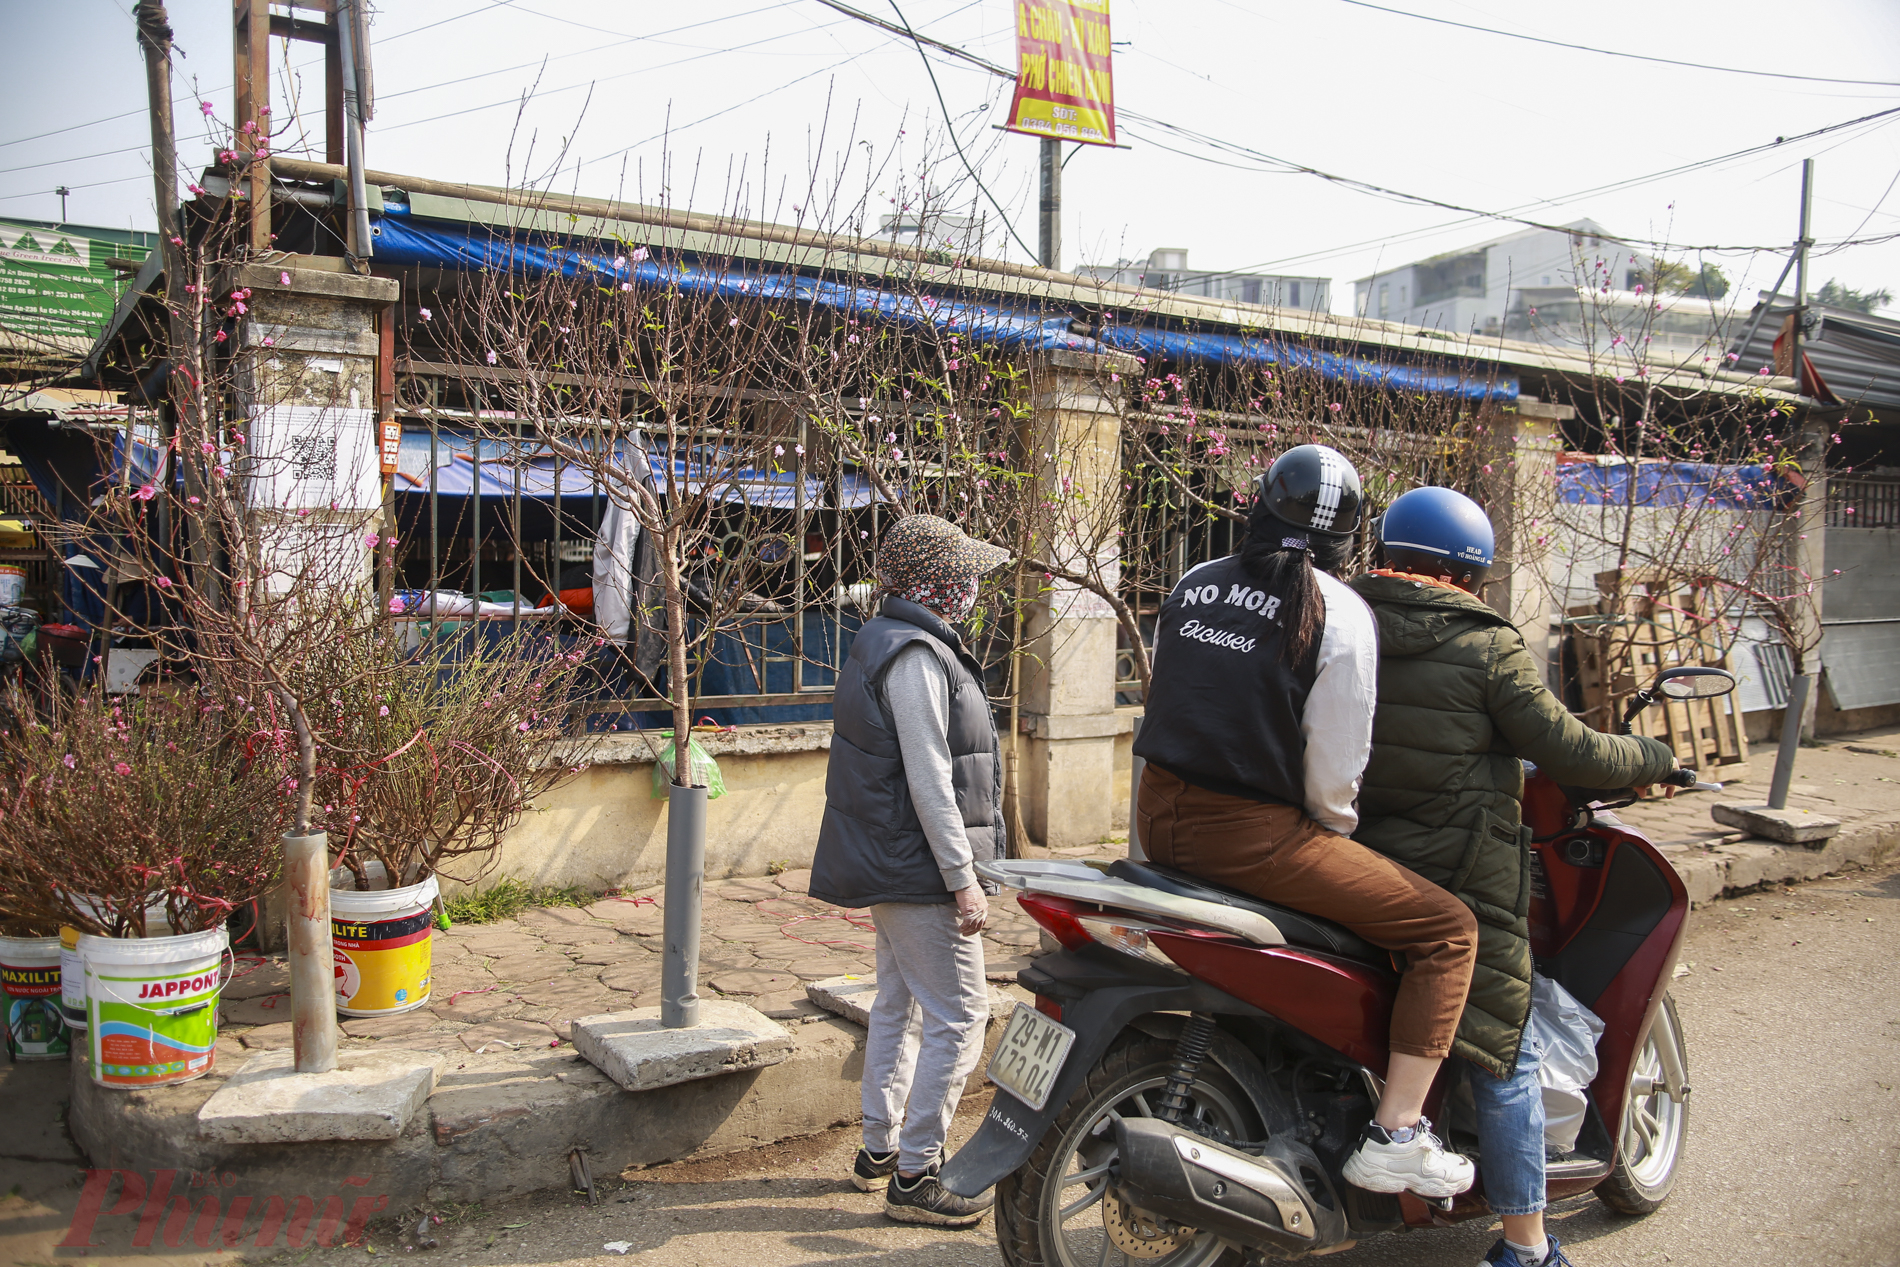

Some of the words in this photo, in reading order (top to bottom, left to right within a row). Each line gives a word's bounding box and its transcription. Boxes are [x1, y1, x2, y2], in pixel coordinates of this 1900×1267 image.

[1087, 16, 1110, 57] XÀO
[1020, 44, 1047, 91] PHỞ
[1048, 56, 1082, 98] CHIÊN
[1052, 106, 1078, 121] SĐT:
[1022, 117, 1052, 132] 0384
[1056, 123, 1078, 136] 056
[13, 251, 39, 260] Green
[1466, 546, 1482, 555] HEAD
[1181, 584, 1219, 608] NO
[1223, 583, 1284, 628] MOR
[1179, 619, 1256, 653] Excuses
[2, 969, 61, 983] MAXILIT
[138, 971, 220, 999] JAPPONT
[30, 985, 49, 994] NGOÀI
[1011, 1013, 1062, 1064] 29-M1
